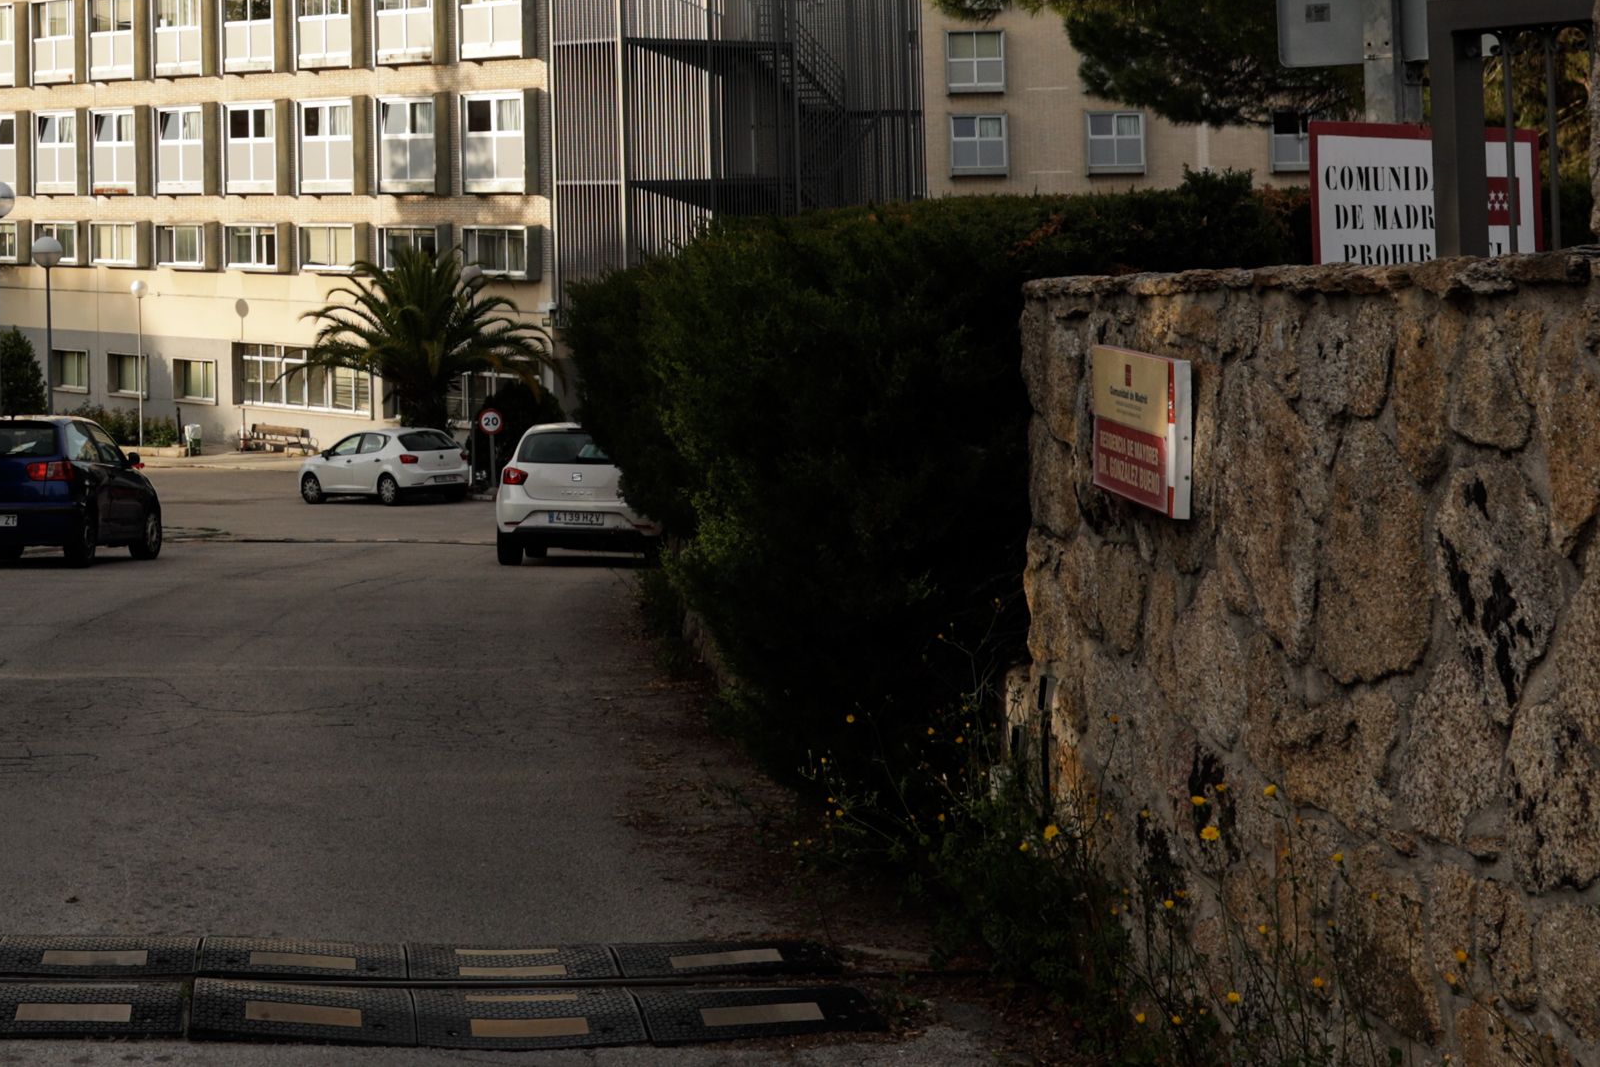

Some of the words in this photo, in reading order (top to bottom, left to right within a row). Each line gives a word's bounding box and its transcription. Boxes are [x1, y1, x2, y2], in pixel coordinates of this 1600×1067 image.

[1324, 165, 1435, 192] COMUNID
[1334, 204, 1364, 230] DE
[1373, 204, 1436, 230] MADR
[484, 417, 499, 427] 20
[1099, 430, 1126, 454] RESIDENCIA
[1127, 439, 1135, 458] DE
[1135, 441, 1159, 466] MAYORES
[1139, 466, 1160, 496] BUENO
[4, 515, 16, 525] ZT
[555, 512, 580, 522] 4139
